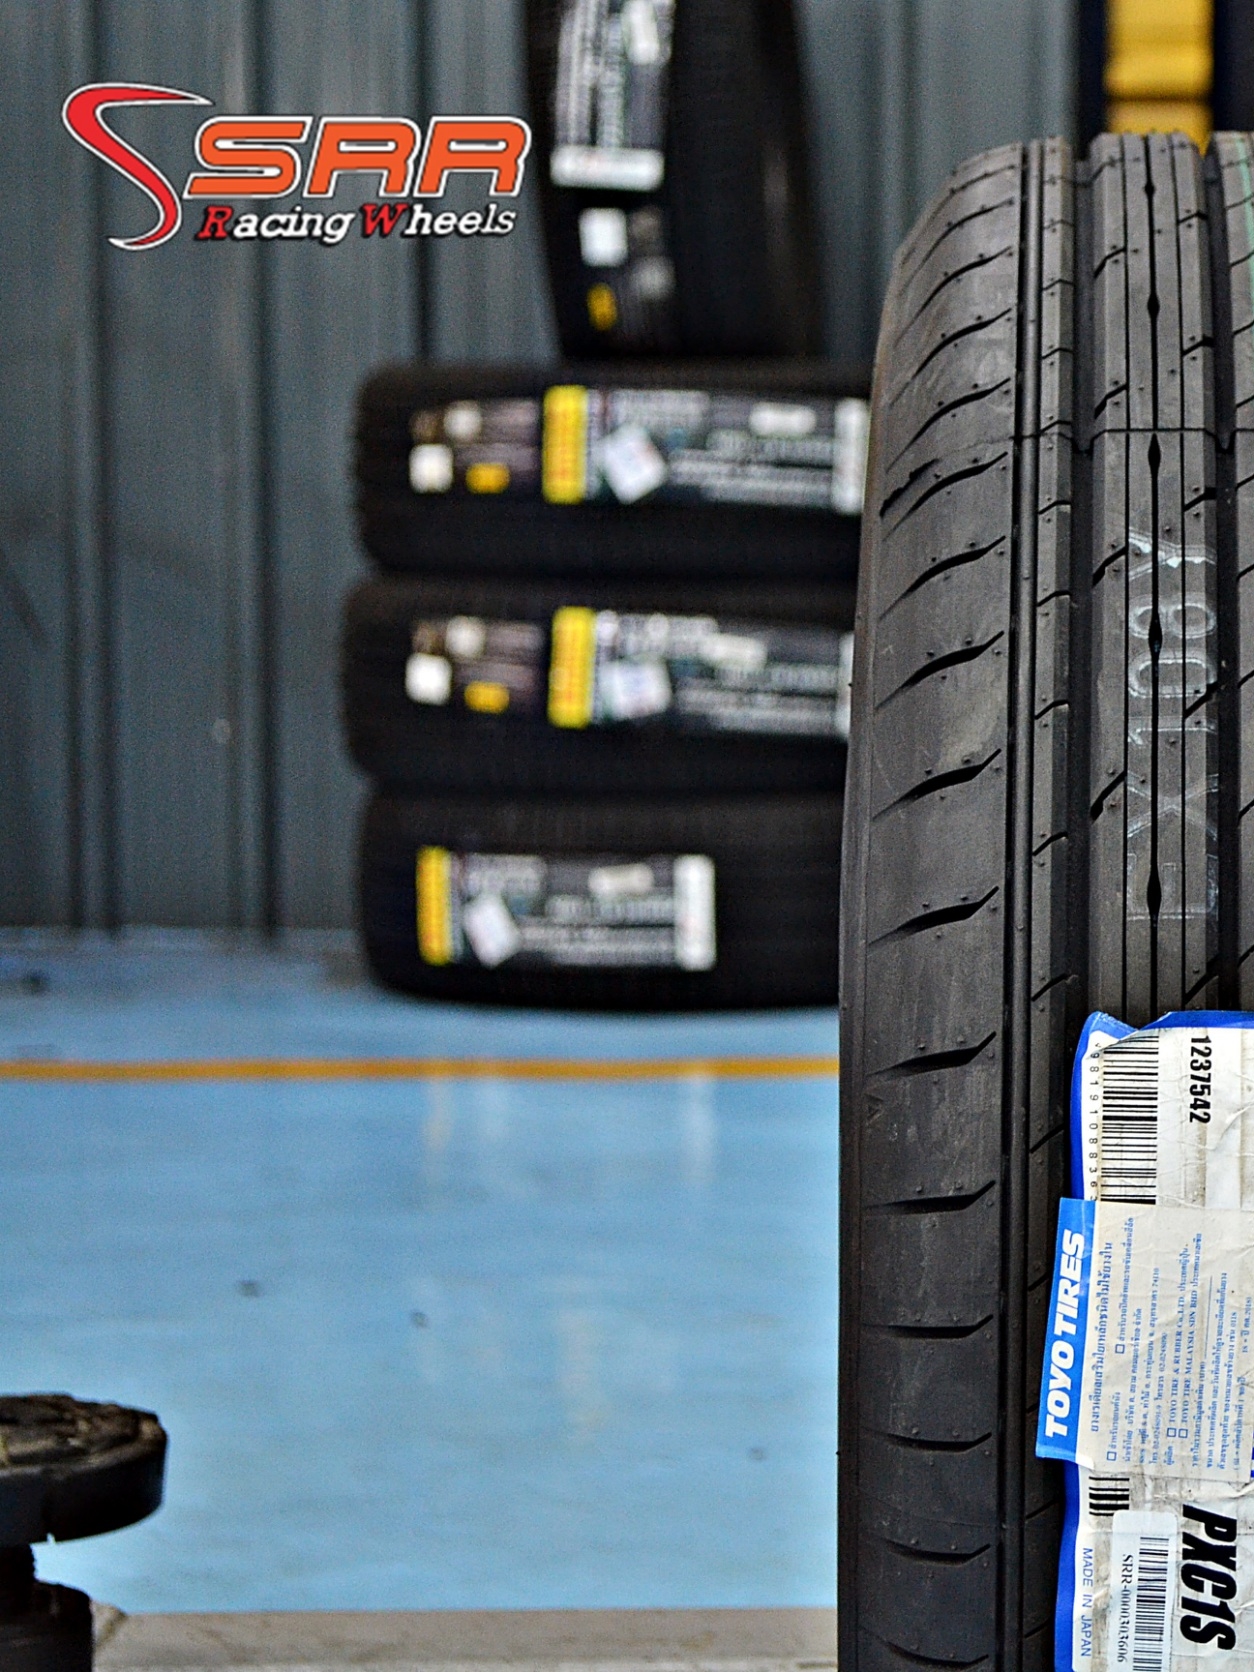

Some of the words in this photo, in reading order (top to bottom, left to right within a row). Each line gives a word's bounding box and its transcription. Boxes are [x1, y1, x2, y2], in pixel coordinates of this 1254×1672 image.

[1190, 1036, 1212, 1124] 1237542
[1055, 1229, 1085, 1336] TIRES
[1045, 1340, 1075, 1438] TOYO
[1082, 1594, 1092, 1608] IN
[1083, 1548, 1093, 1587] MADE
[1117, 1554, 1135, 1663] SRR-0000303606
[1180, 1504, 1237, 1650] PXC1S
[1081, 1615, 1091, 1657] JAPAN
